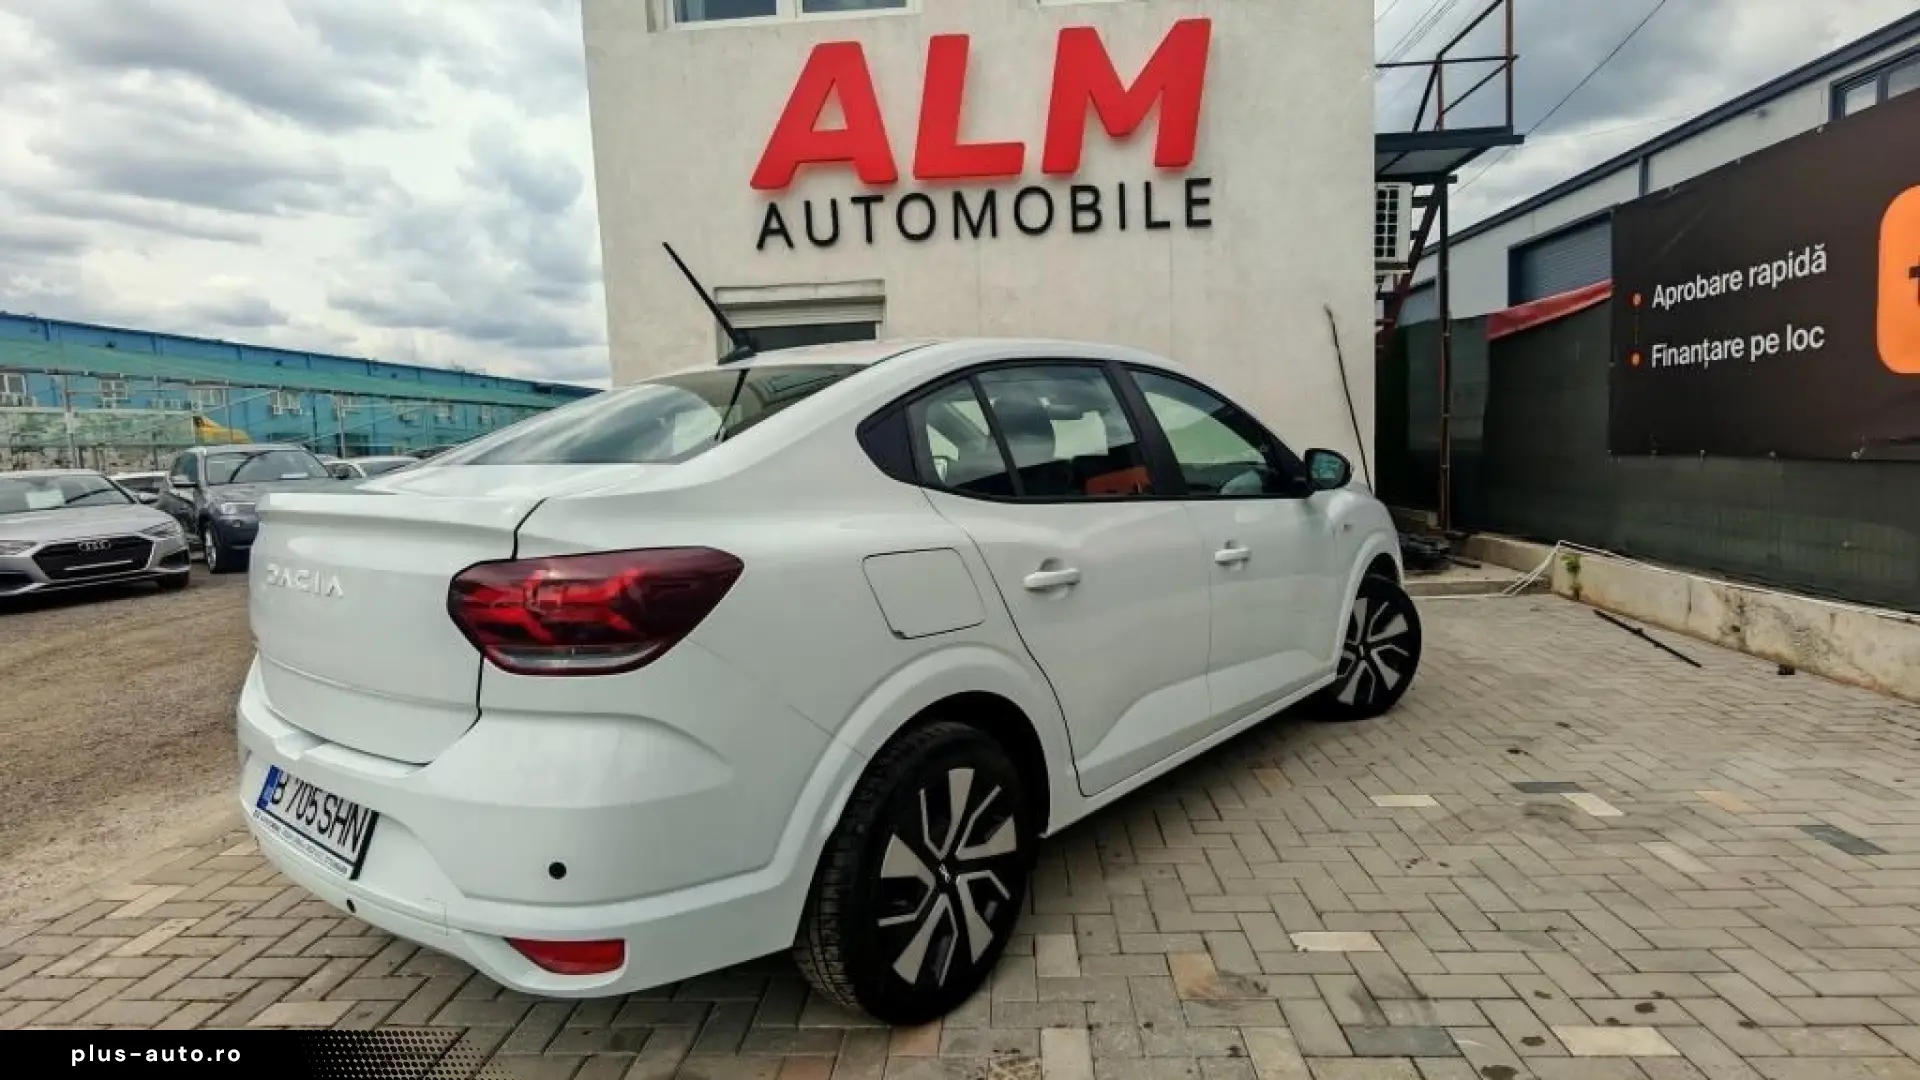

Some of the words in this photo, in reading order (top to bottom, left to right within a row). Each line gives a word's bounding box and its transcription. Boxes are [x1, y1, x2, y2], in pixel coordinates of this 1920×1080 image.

[750, 18, 1212, 190] ALM
[756, 177, 1212, 250] AUTOMOBILE
[1652, 269, 1744, 311] Aprobare
[1748, 243, 1827, 290] rapidă
[1652, 336, 1745, 370] Finanțare
[1750, 332, 1780, 363] pe
[1786, 323, 1826, 352] loc
[285, 778, 322, 826] 705
[316, 792, 370, 854] SHN
